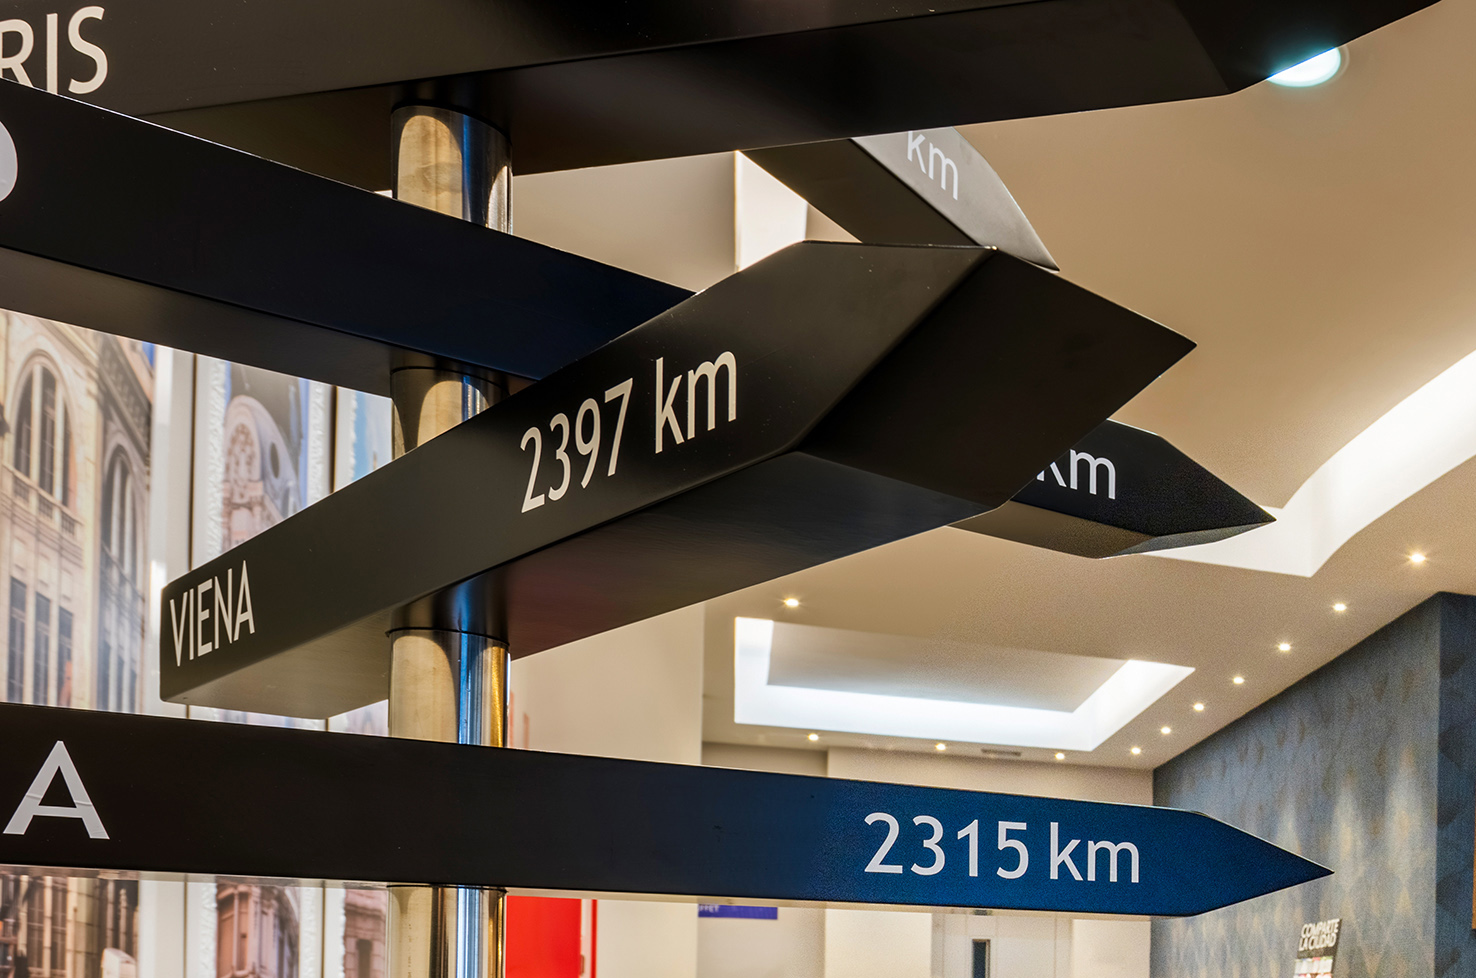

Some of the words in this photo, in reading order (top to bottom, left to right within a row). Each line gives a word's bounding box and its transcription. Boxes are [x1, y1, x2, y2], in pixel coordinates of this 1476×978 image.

[169, 560, 256, 667] VIENA
[521, 378, 633, 513] 2397
[654, 350, 738, 454] km
[3, 740, 110, 839] A
[864, 812, 1029, 879] 2315
[1048, 822, 1141, 884] km
[1301, 918, 1340, 938] COMPARTE
[1308, 932, 1337, 950] CIUDAD
